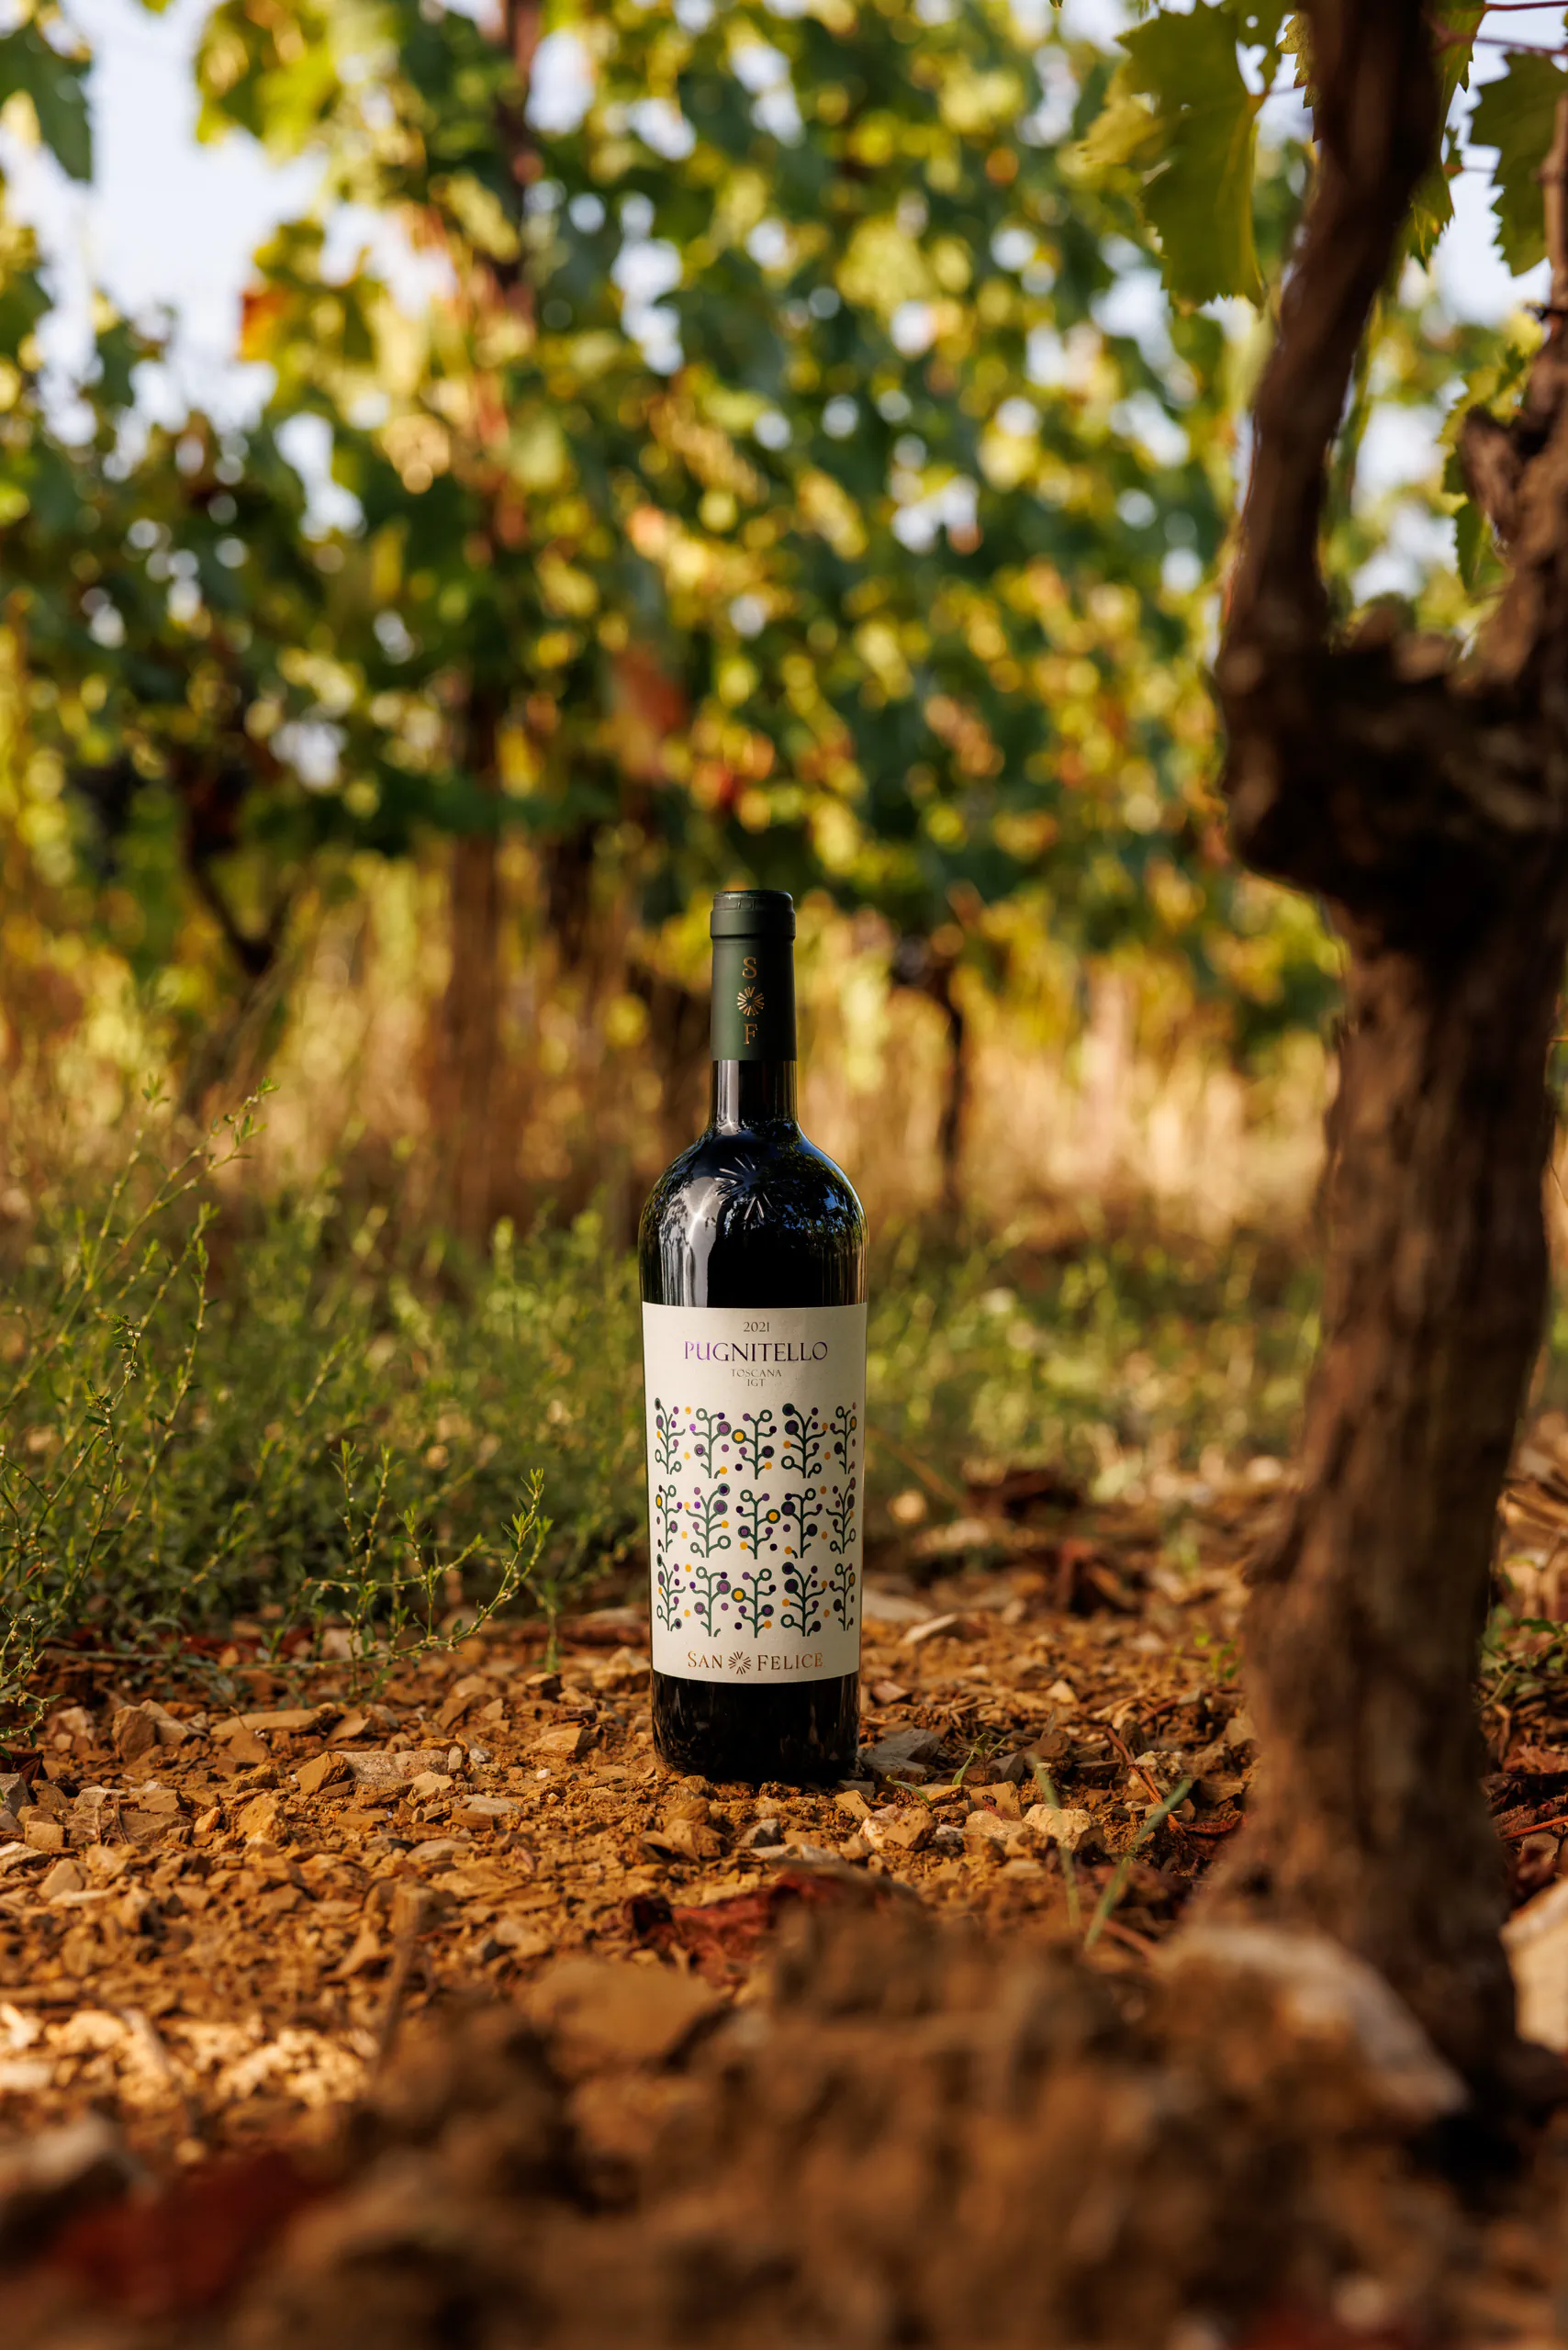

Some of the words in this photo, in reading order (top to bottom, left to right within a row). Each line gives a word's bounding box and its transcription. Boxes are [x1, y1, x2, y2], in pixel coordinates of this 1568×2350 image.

[742, 956, 757, 979] S
[743, 1023, 758, 1045] F
[743, 1321, 770, 1333] 2021
[684, 1340, 828, 1362] PUGNITELLO
[731, 1368, 782, 1378] TOSCANA
[746, 1378, 766, 1387] IGT
[687, 1650, 722, 1669] SAN
[757, 1652, 823, 1672] FELICE
